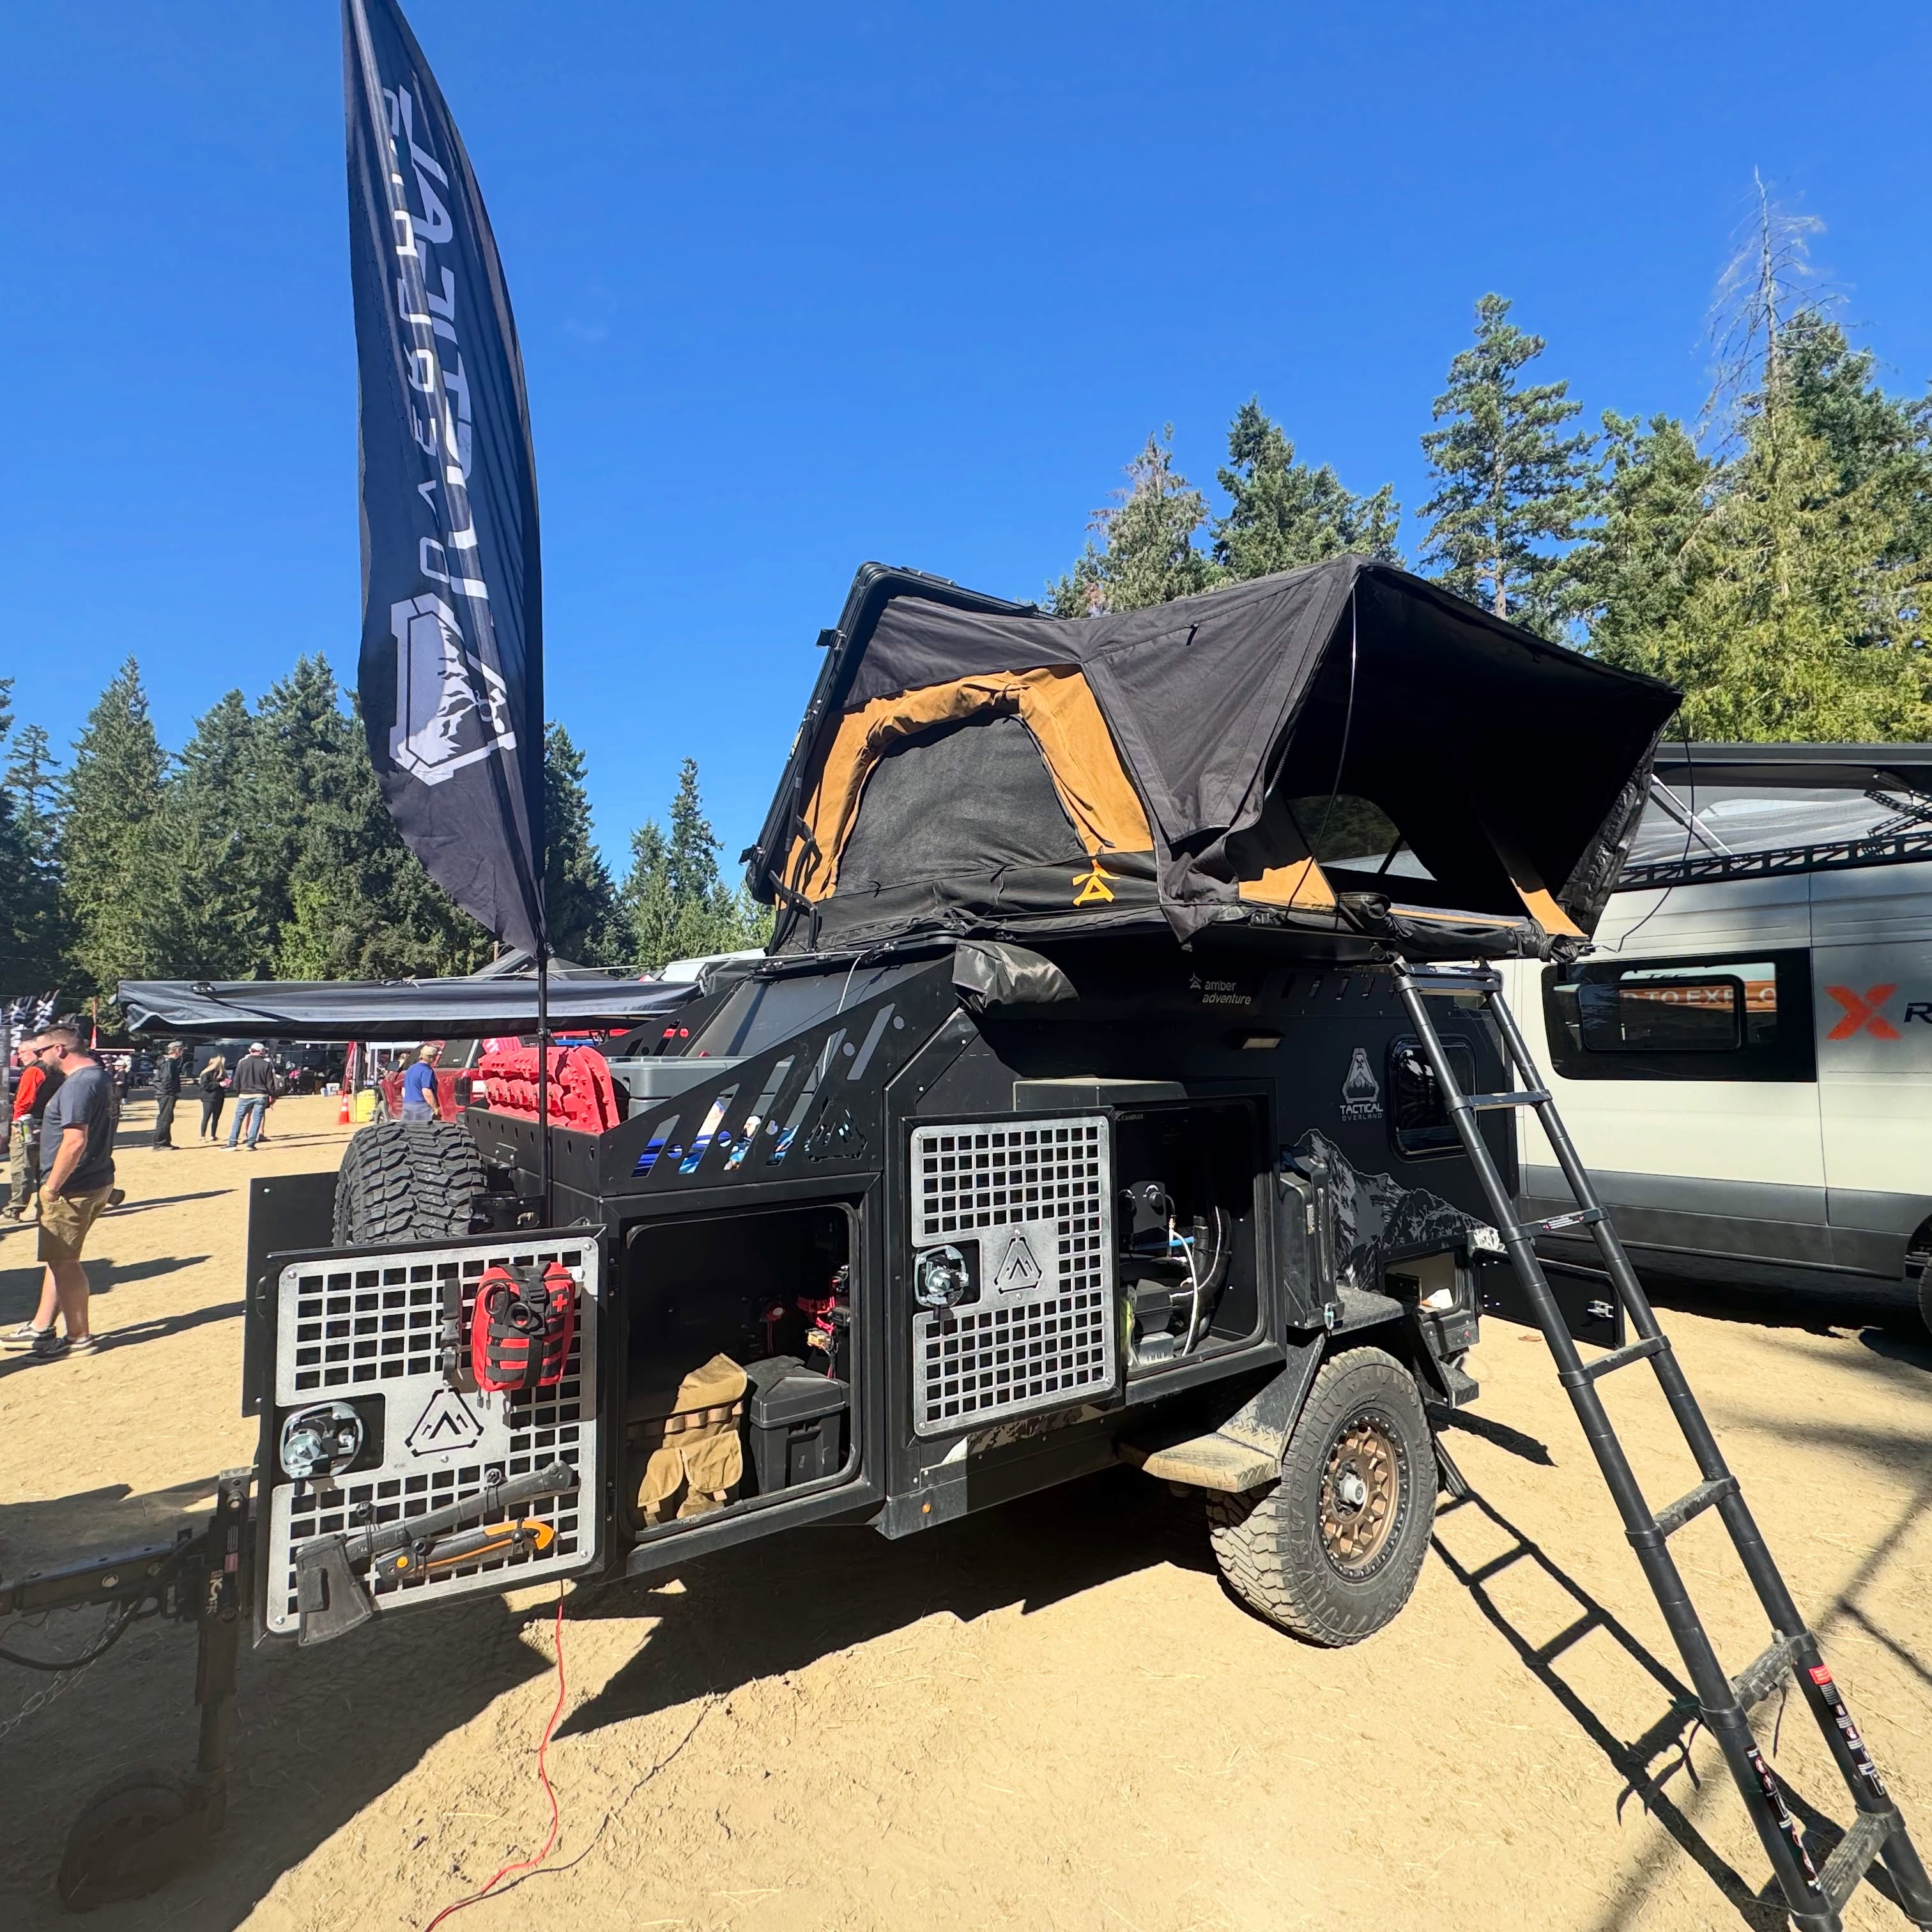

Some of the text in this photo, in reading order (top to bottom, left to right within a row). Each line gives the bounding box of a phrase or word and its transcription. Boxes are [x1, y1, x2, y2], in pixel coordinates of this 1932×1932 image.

[1204, 979, 1237, 992] amber
[1202, 992, 1252, 1005] adventure
[1339, 1103, 1384, 1115] TACTICAL
[1342, 1112, 1383, 1122] OVERLAND
